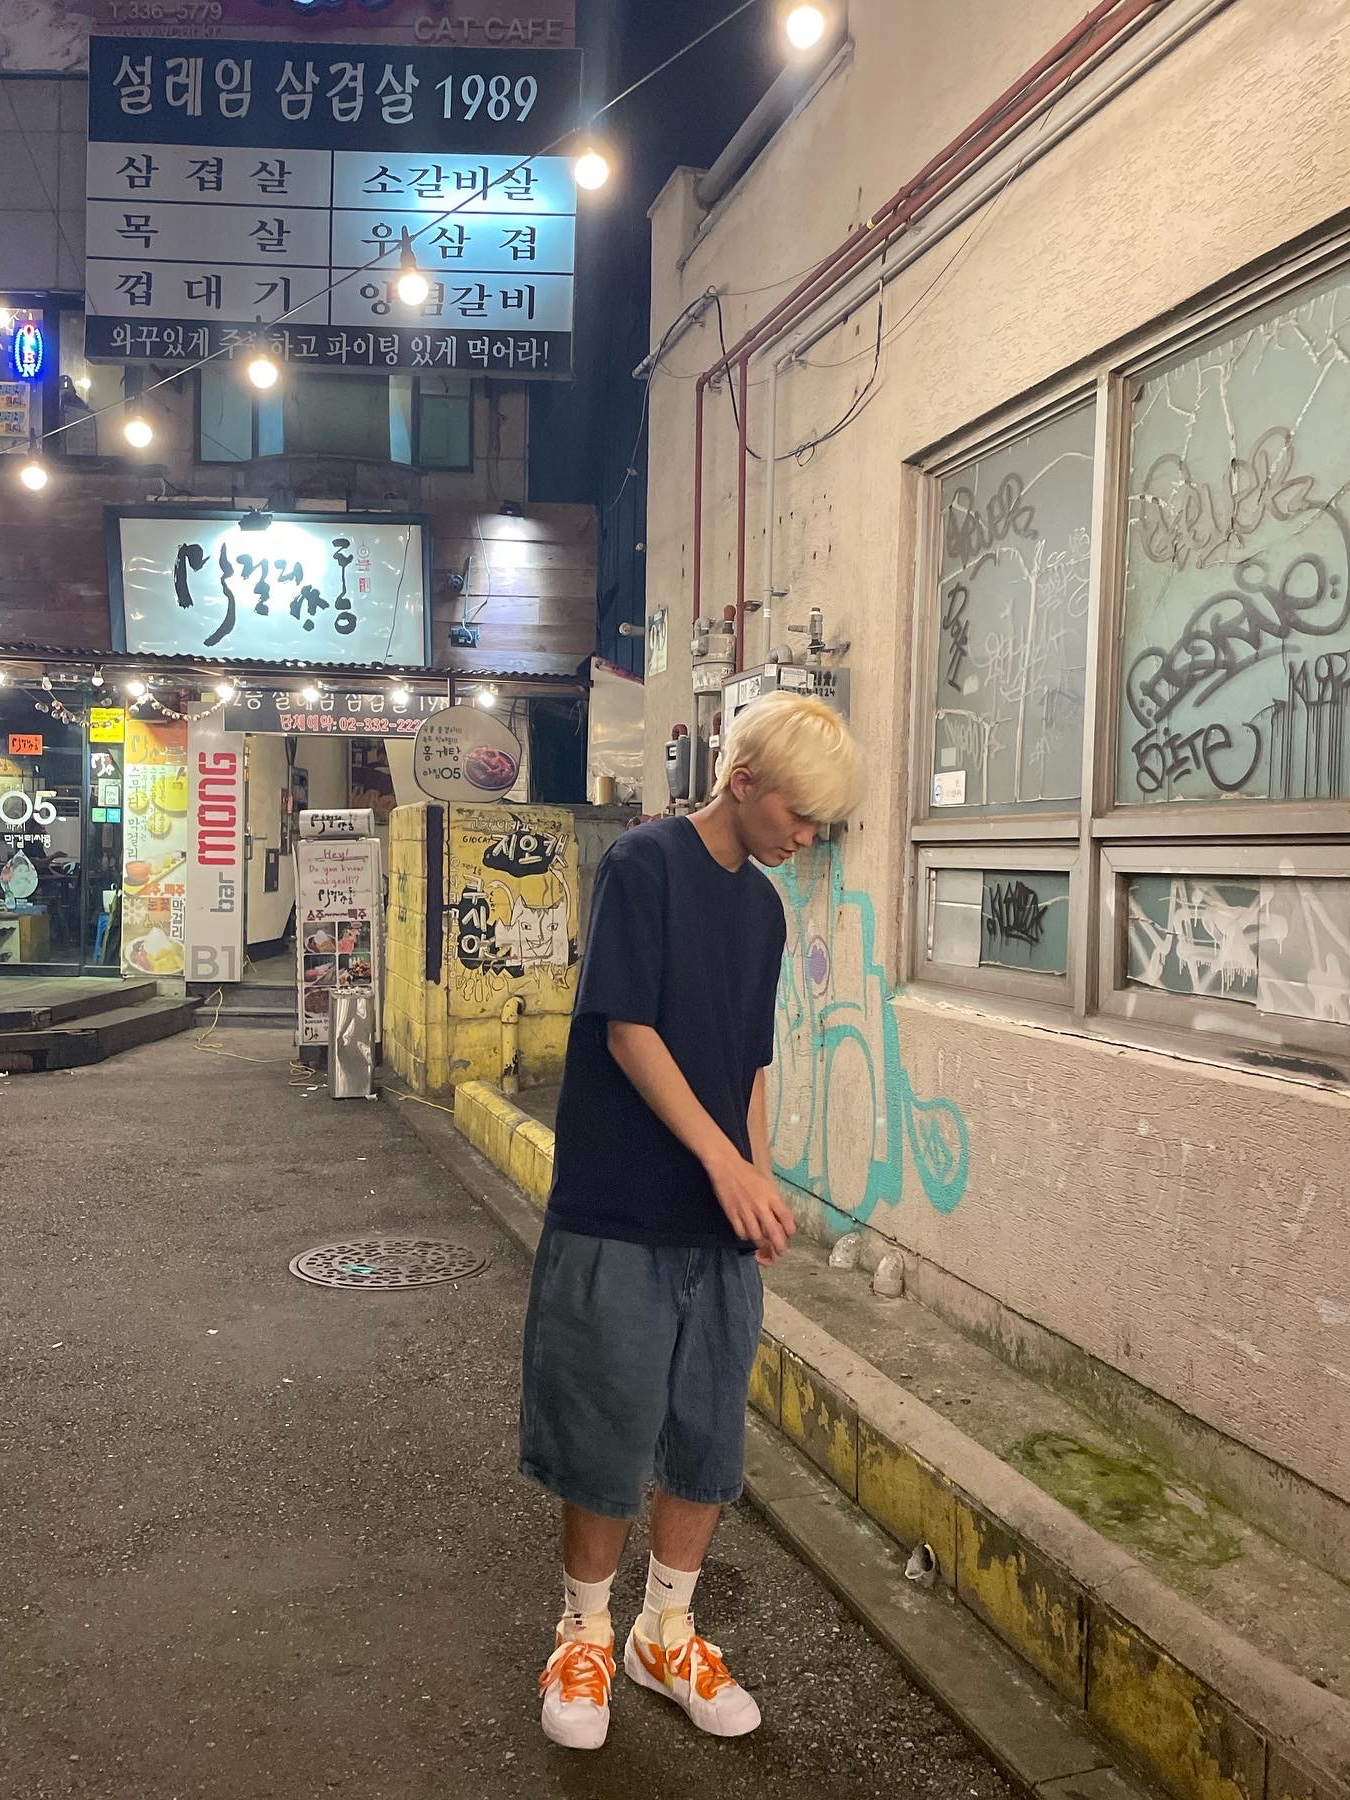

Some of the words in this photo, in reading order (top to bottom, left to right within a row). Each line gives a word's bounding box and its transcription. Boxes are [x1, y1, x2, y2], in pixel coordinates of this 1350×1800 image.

[414, 16, 476, 41] CAT
[485, 17, 564, 43] CAFE
[113, 56, 252, 118] 설레임
[275, 60, 420, 124] 삼겹살
[435, 74, 538, 122] 1989
[362, 164, 538, 200] 소갈비살
[110, 323, 209, 357] 와꾸있게
[326, 332, 399, 365] 파이팅
[411, 335, 457, 367] 있게
[467, 335, 549, 368] 먹어라!
[338, 716, 421, 733] 02-332-222
[209, 872, 235, 913] bar
[191, 945, 235, 981] B1
